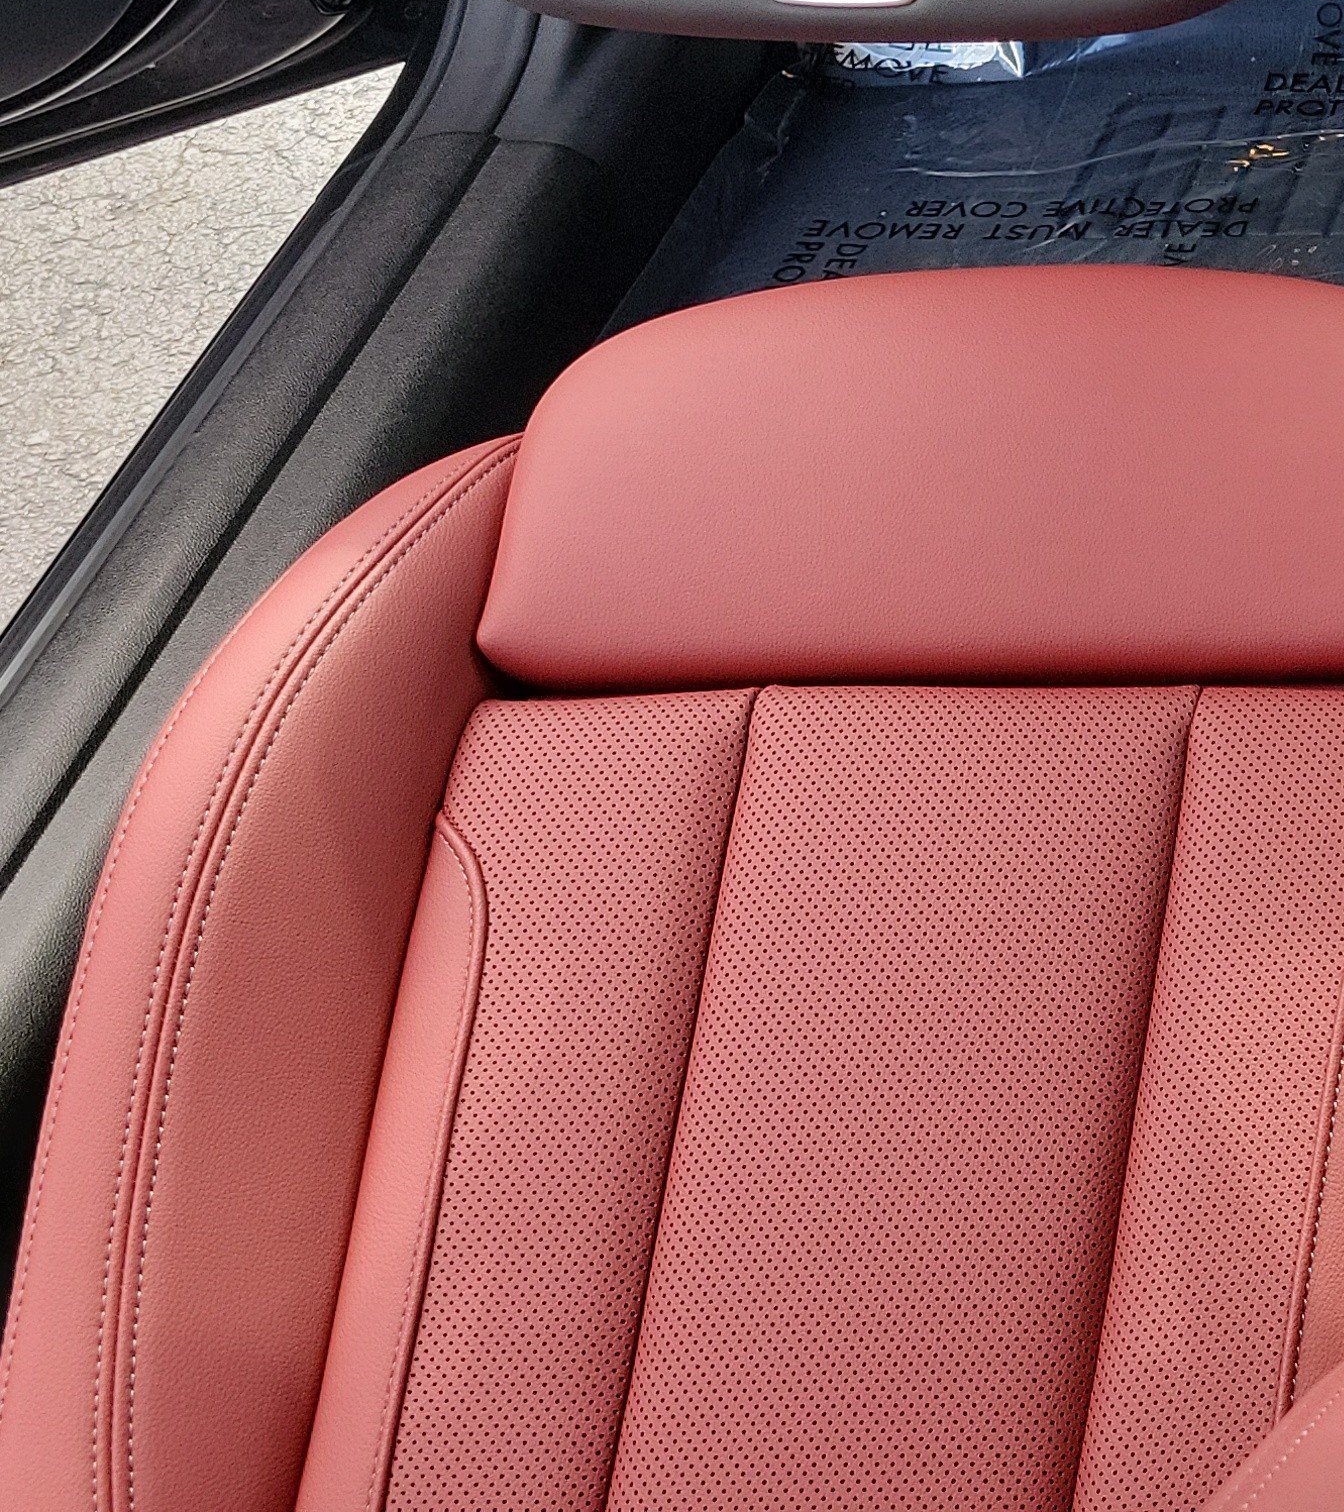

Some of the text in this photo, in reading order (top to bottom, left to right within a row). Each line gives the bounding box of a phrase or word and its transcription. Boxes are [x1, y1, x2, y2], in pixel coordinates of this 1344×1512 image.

[905, 197, 1261, 220] PROTECTIVE COVER
[801, 218, 1249, 242] DEALER MUST REMOVE
